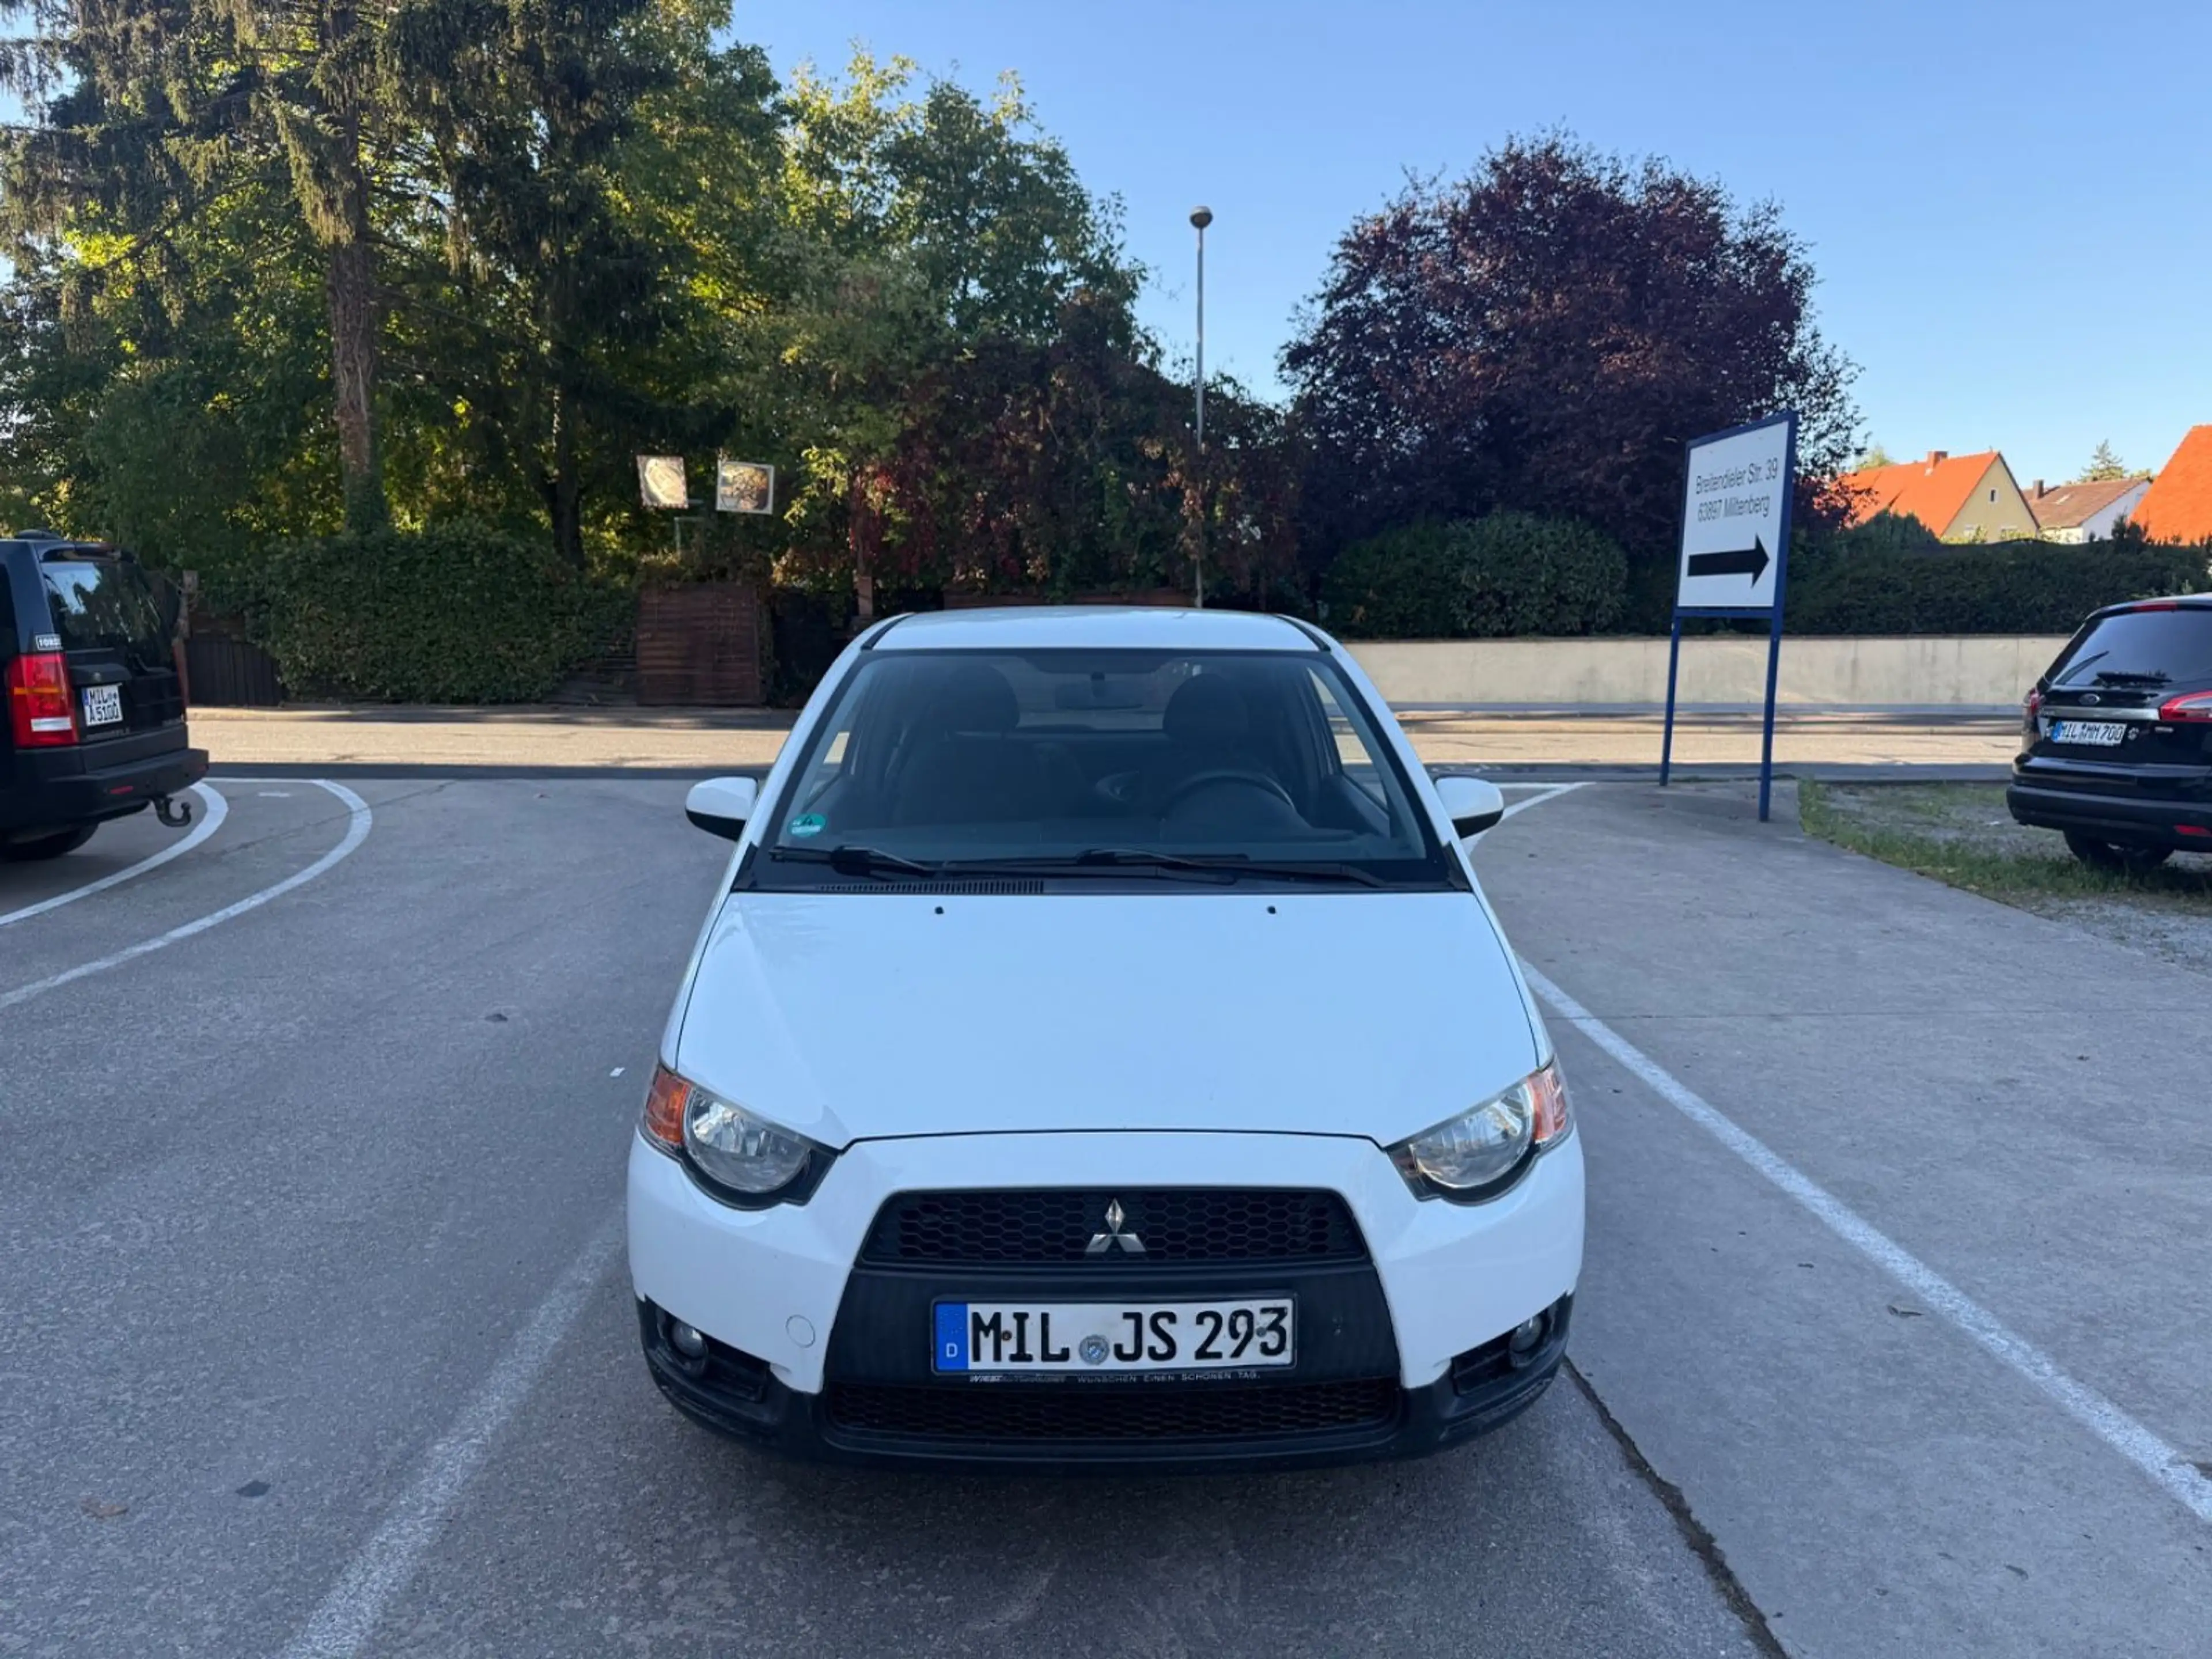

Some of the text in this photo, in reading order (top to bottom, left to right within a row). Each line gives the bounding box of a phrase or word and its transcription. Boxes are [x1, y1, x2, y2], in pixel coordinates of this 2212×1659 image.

[1748, 463, 1763, 484] Str.
[1766, 457, 1778, 481] 39
[89, 688, 108, 704] MIL
[2059, 722, 2077, 738] MIL
[2100, 724, 2124, 741] 700
[945, 1306, 1289, 1362] D MIL JS 293
